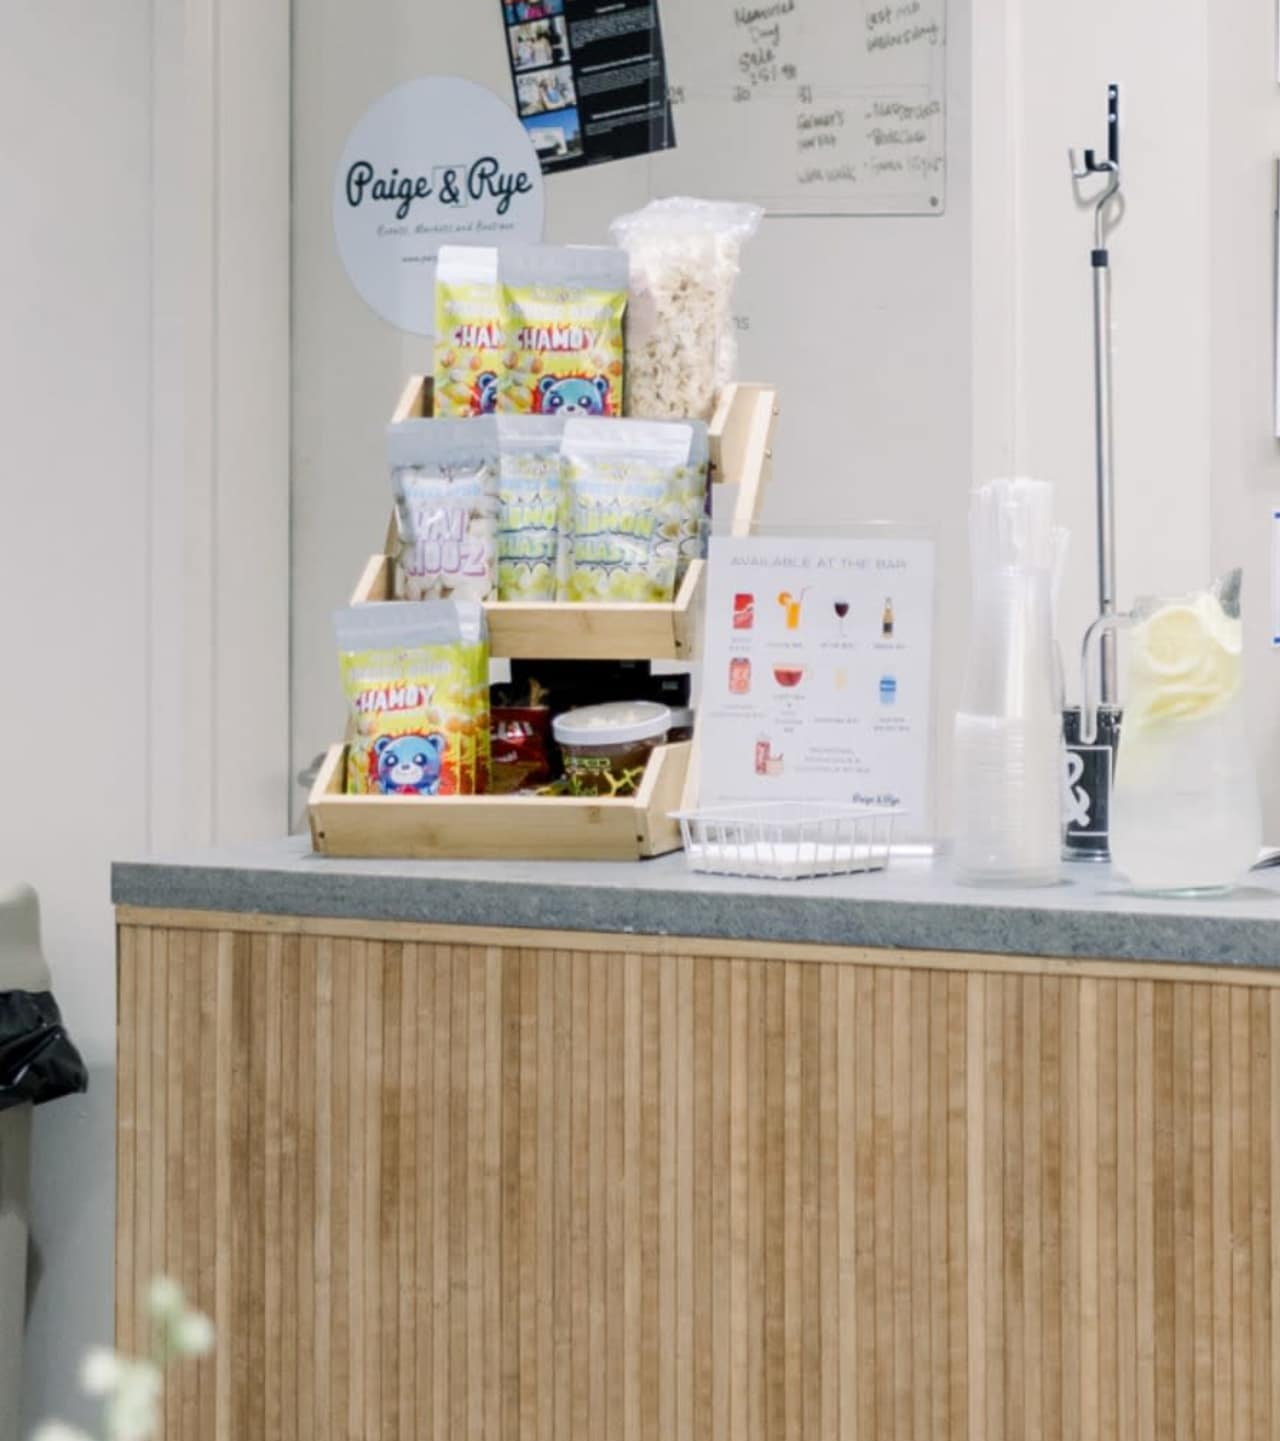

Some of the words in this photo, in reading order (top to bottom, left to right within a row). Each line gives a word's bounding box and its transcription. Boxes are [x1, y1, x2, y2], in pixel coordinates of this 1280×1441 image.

[346, 161, 432, 220] Paige
[439, 169, 460, 204] &
[467, 157, 533, 215] Rye
[730, 556, 811, 569] AVAILABLE
[817, 558, 835, 569] AT
[841, 558, 868, 570] THE
